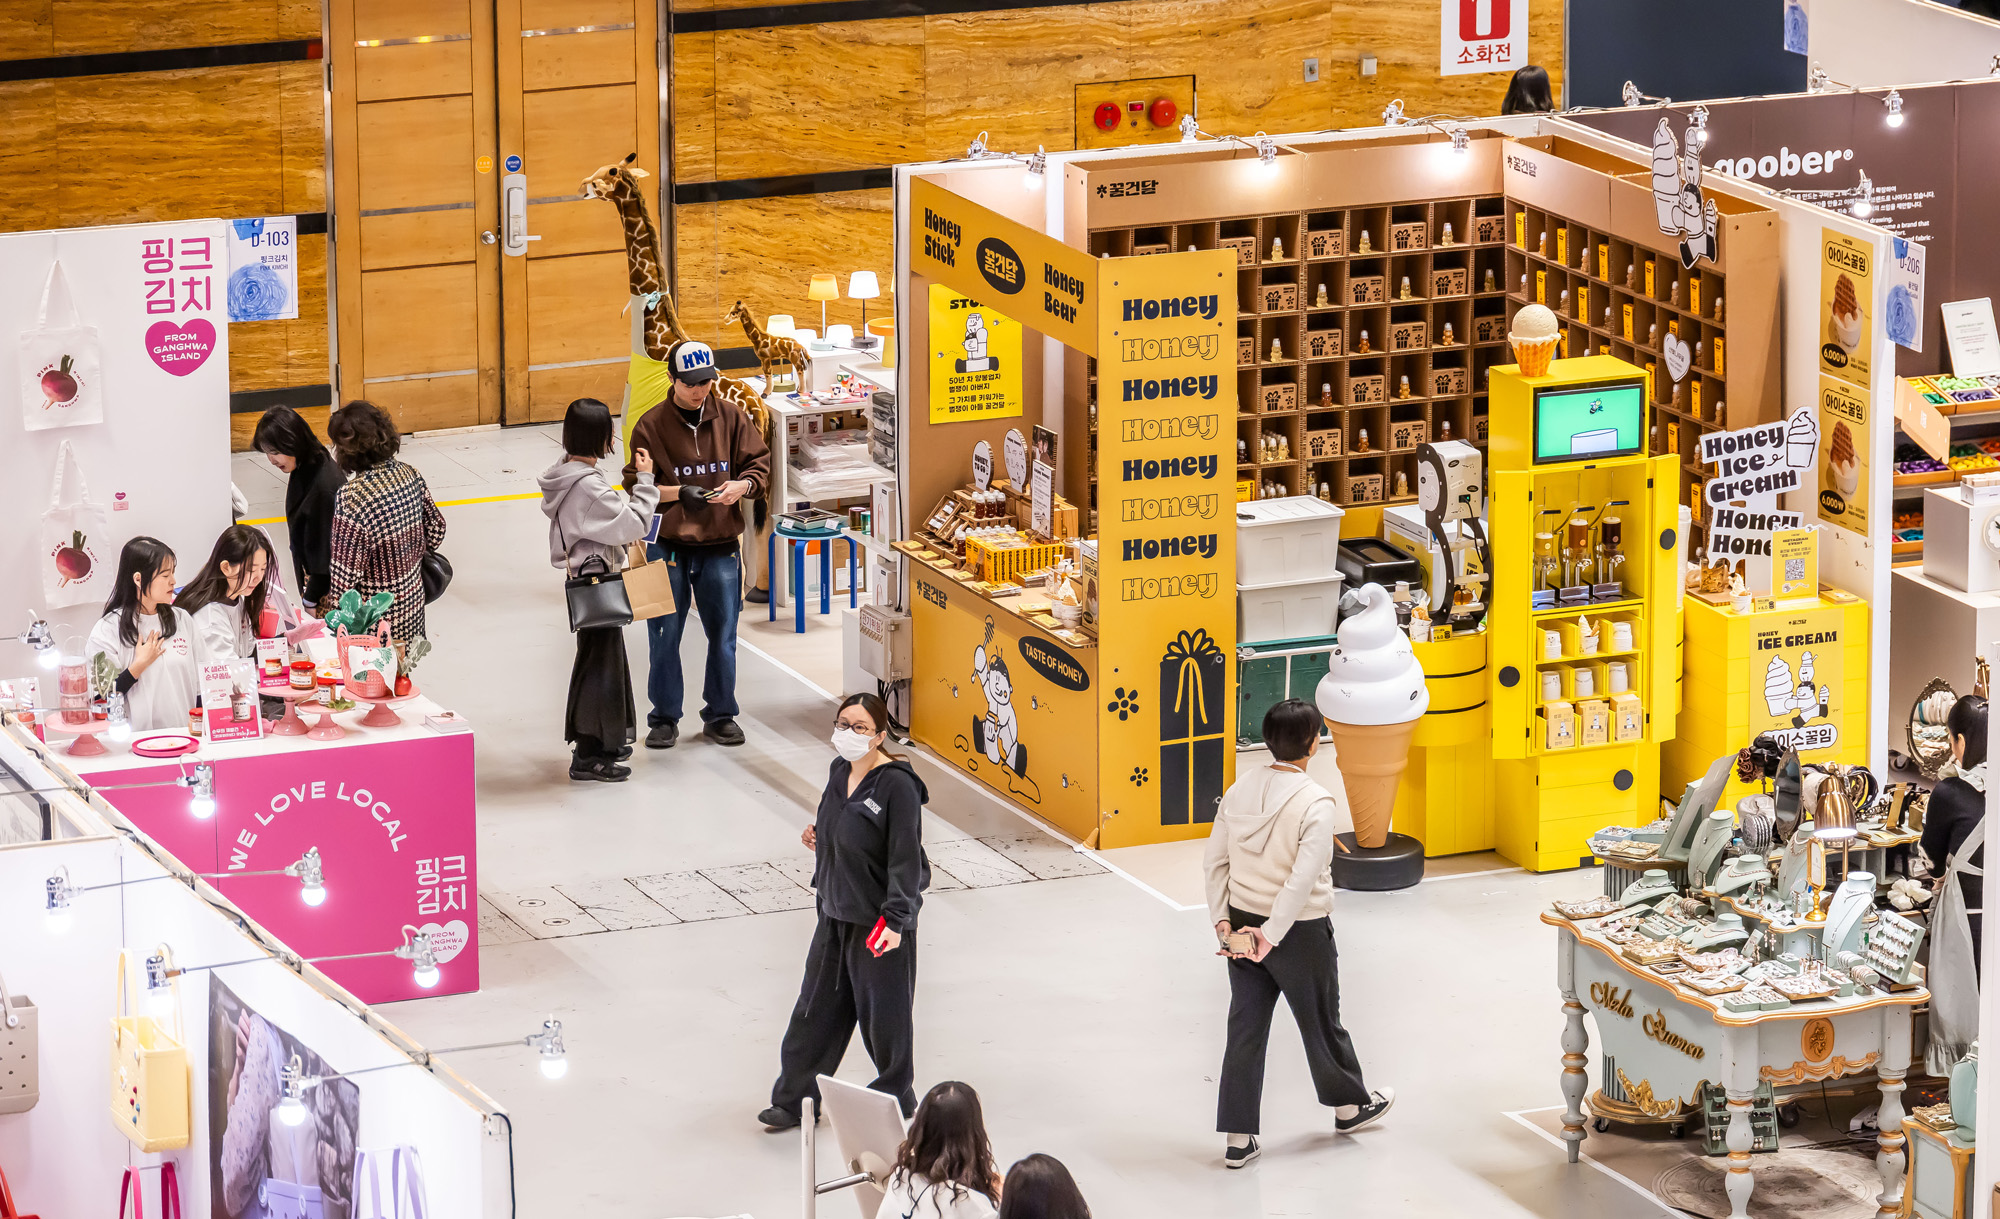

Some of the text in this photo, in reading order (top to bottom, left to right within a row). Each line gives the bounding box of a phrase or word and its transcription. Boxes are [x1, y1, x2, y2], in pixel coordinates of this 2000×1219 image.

[1456, 42, 1512, 65] 소화전
[251, 230, 289, 248] D-103
[924, 207, 961, 247] Honey
[141, 237, 214, 275] 핑크
[260, 254, 288, 264] 핑크김치
[924, 236, 956, 268] Stick
[1828, 246, 1866, 272] 아이스꿀임
[1900, 253, 1920, 275] D-206
[144, 276, 212, 315] 김치
[1044, 262, 1085, 308] Honey
[1044, 291, 1077, 324] Bear
[1122, 294, 1219, 322] Honey
[153, 340, 208, 355] GANGHWA
[164, 332, 197, 343] FROM
[1121, 333, 1219, 363] Honey
[161, 350, 201, 363] ISLAND
[949, 376, 965, 385] 50년
[970, 383, 990, 391] 아버지
[1122, 374, 1219, 402] Honey
[1825, 393, 1864, 420] 아이스꿀임
[1122, 414, 1219, 442] Honey
[1704, 425, 1785, 459] Honey
[1122, 454, 1218, 482] Honey
[1721, 453, 1766, 478] Ice
[1709, 469, 1798, 503] Cream
[1121, 493, 1219, 522] Honey
[1122, 533, 1218, 562] Honey
[1711, 534, 1772, 557] Hone
[922, 581, 948, 610] 꿀건달
[1121, 572, 1218, 602] Honey
[1757, 631, 1838, 650] ICE CREAM
[1025, 642, 1083, 684] TASTE OF HONEY
[228, 780, 408, 871] WE LOVE LOCAL
[415, 855, 467, 886] 핑크
[416, 884, 467, 915] 김치
[431, 931, 455, 939] FROM
[432, 945, 458, 953] SLAND
